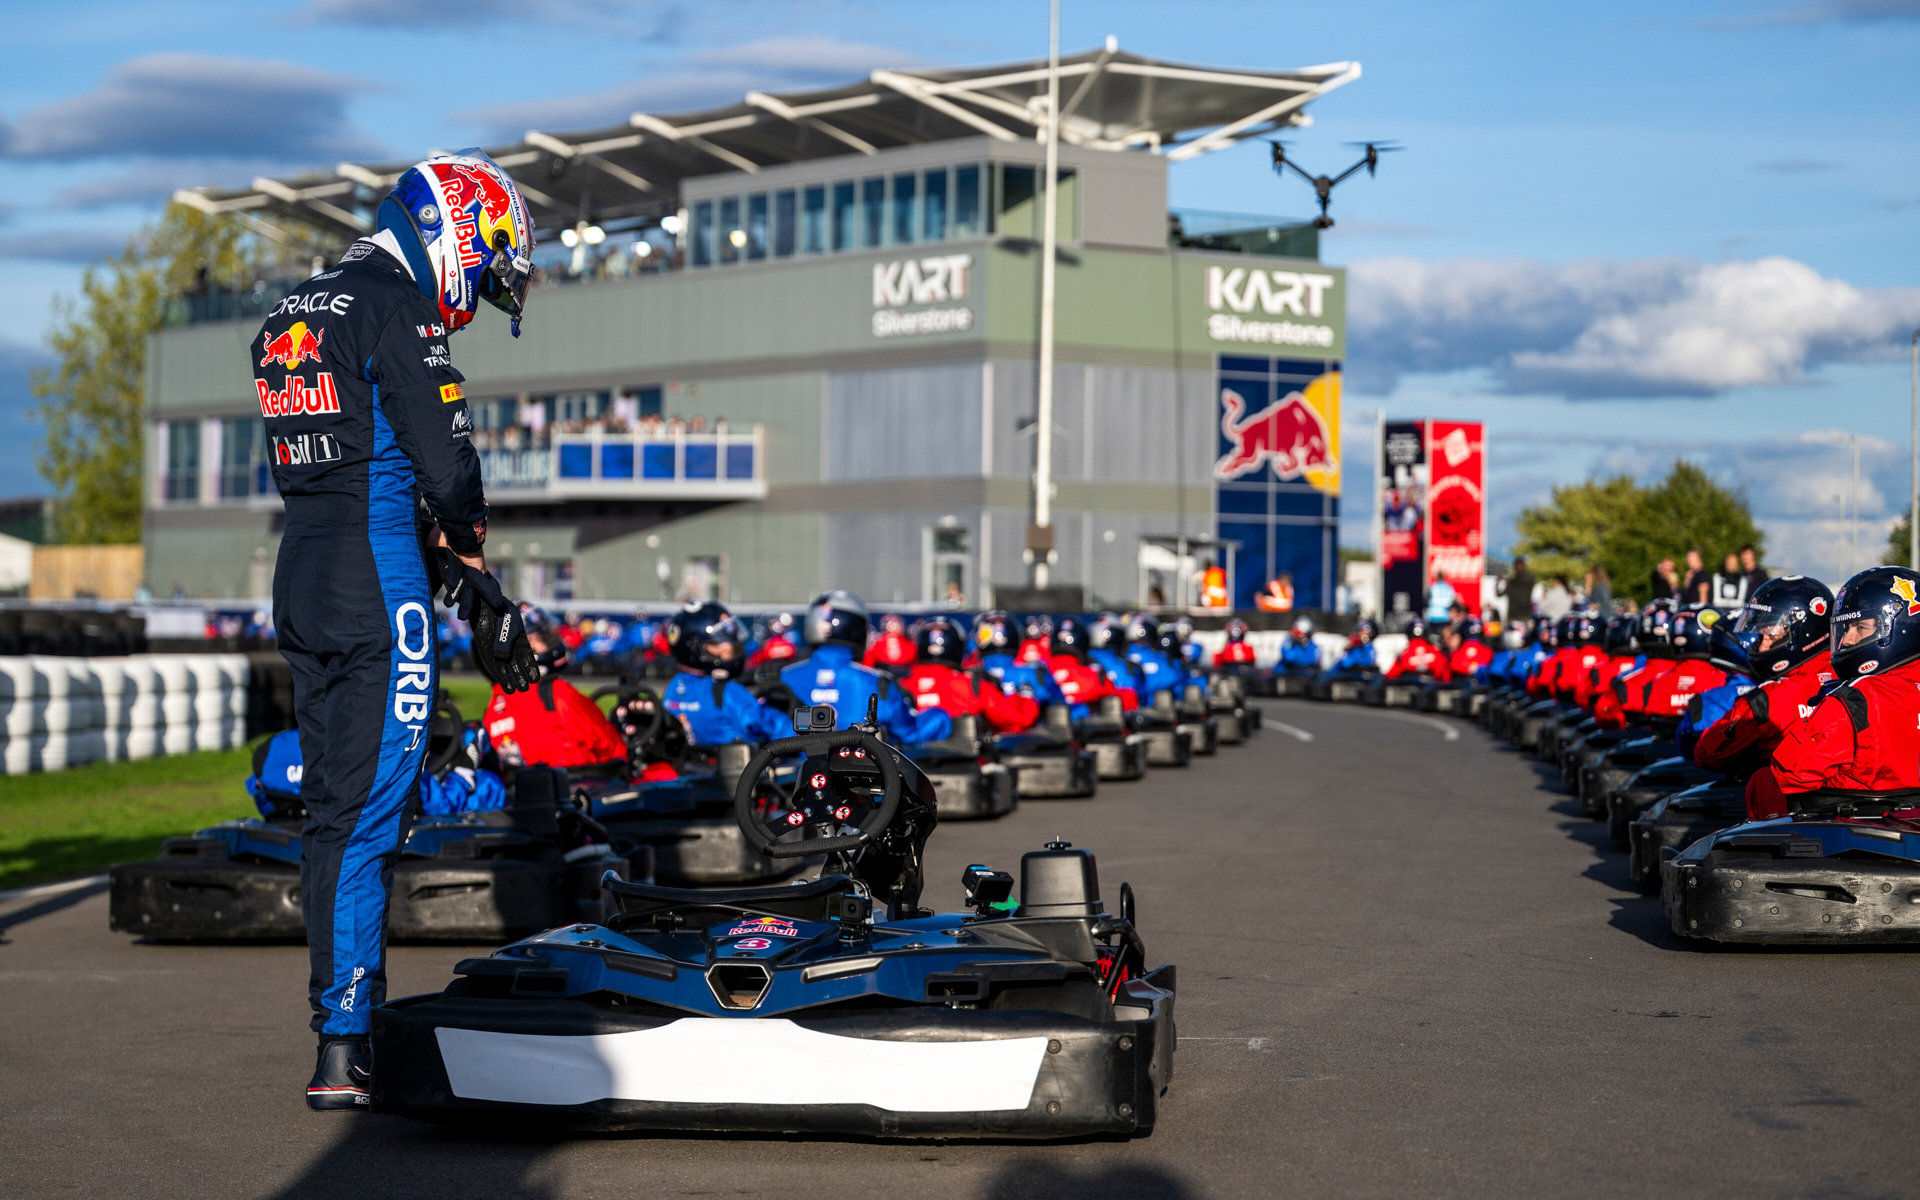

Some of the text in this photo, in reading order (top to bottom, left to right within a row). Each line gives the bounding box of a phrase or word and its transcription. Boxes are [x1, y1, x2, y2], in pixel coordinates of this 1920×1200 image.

[872, 256, 972, 307] KART
[1206, 266, 1334, 317] KART
[268, 291, 355, 318] ORACLE
[1208, 313, 1334, 347] Silverstone
[1860, 662, 1877, 672] BELL
[733, 937, 772, 950] 3
